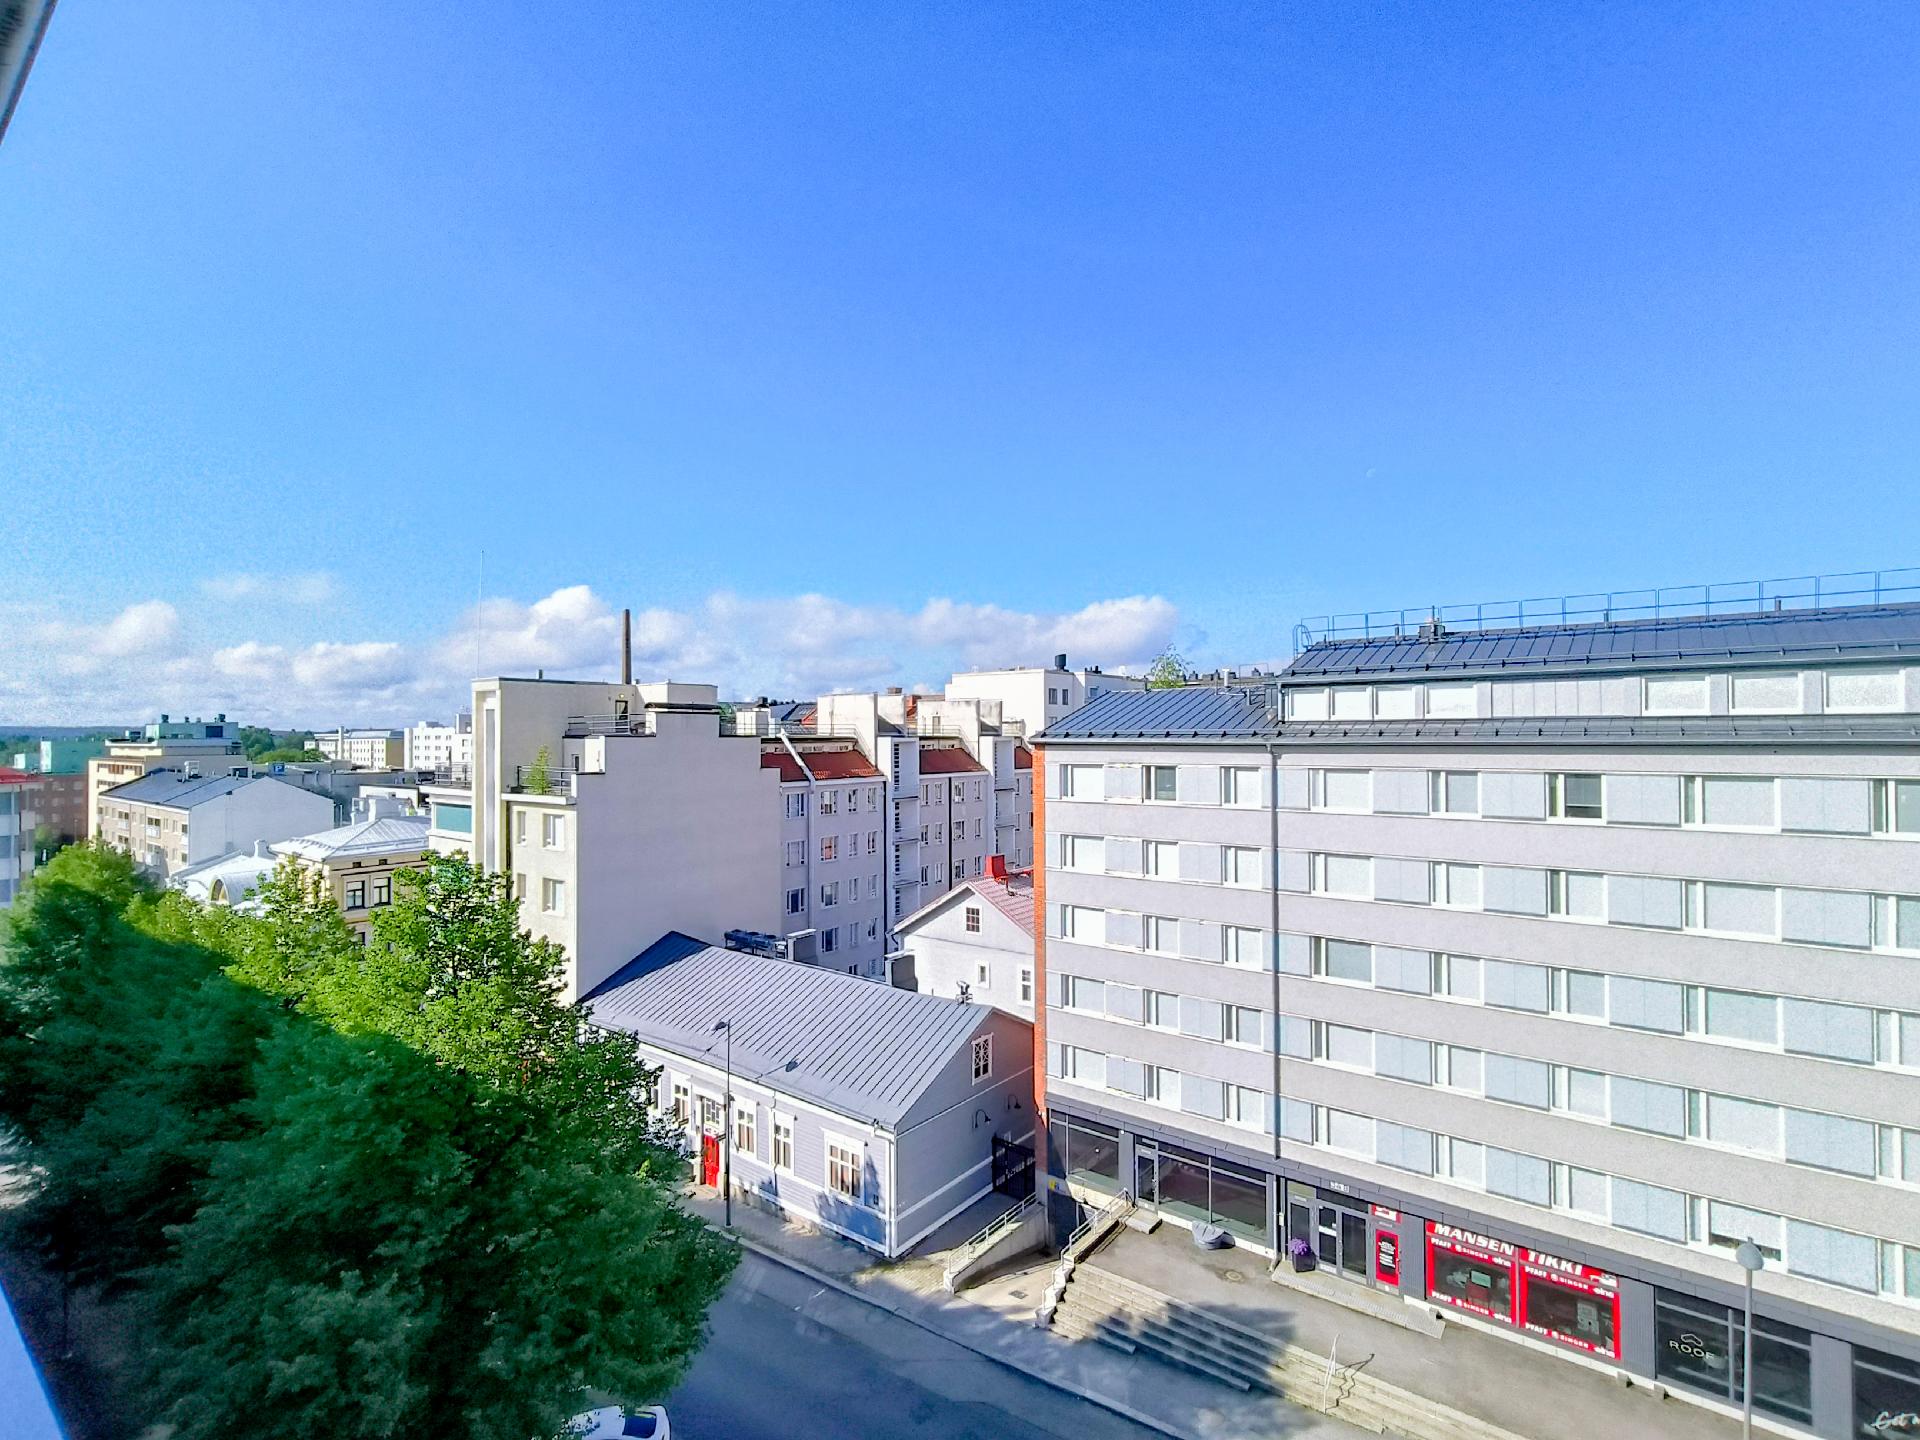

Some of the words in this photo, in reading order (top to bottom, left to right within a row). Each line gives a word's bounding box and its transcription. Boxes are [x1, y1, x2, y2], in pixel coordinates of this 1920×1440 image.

[1434, 1223, 1515, 1256] MANSEN
[1527, 1249, 1583, 1276] TIKKI
[1669, 1340, 1715, 1360] ROOF
